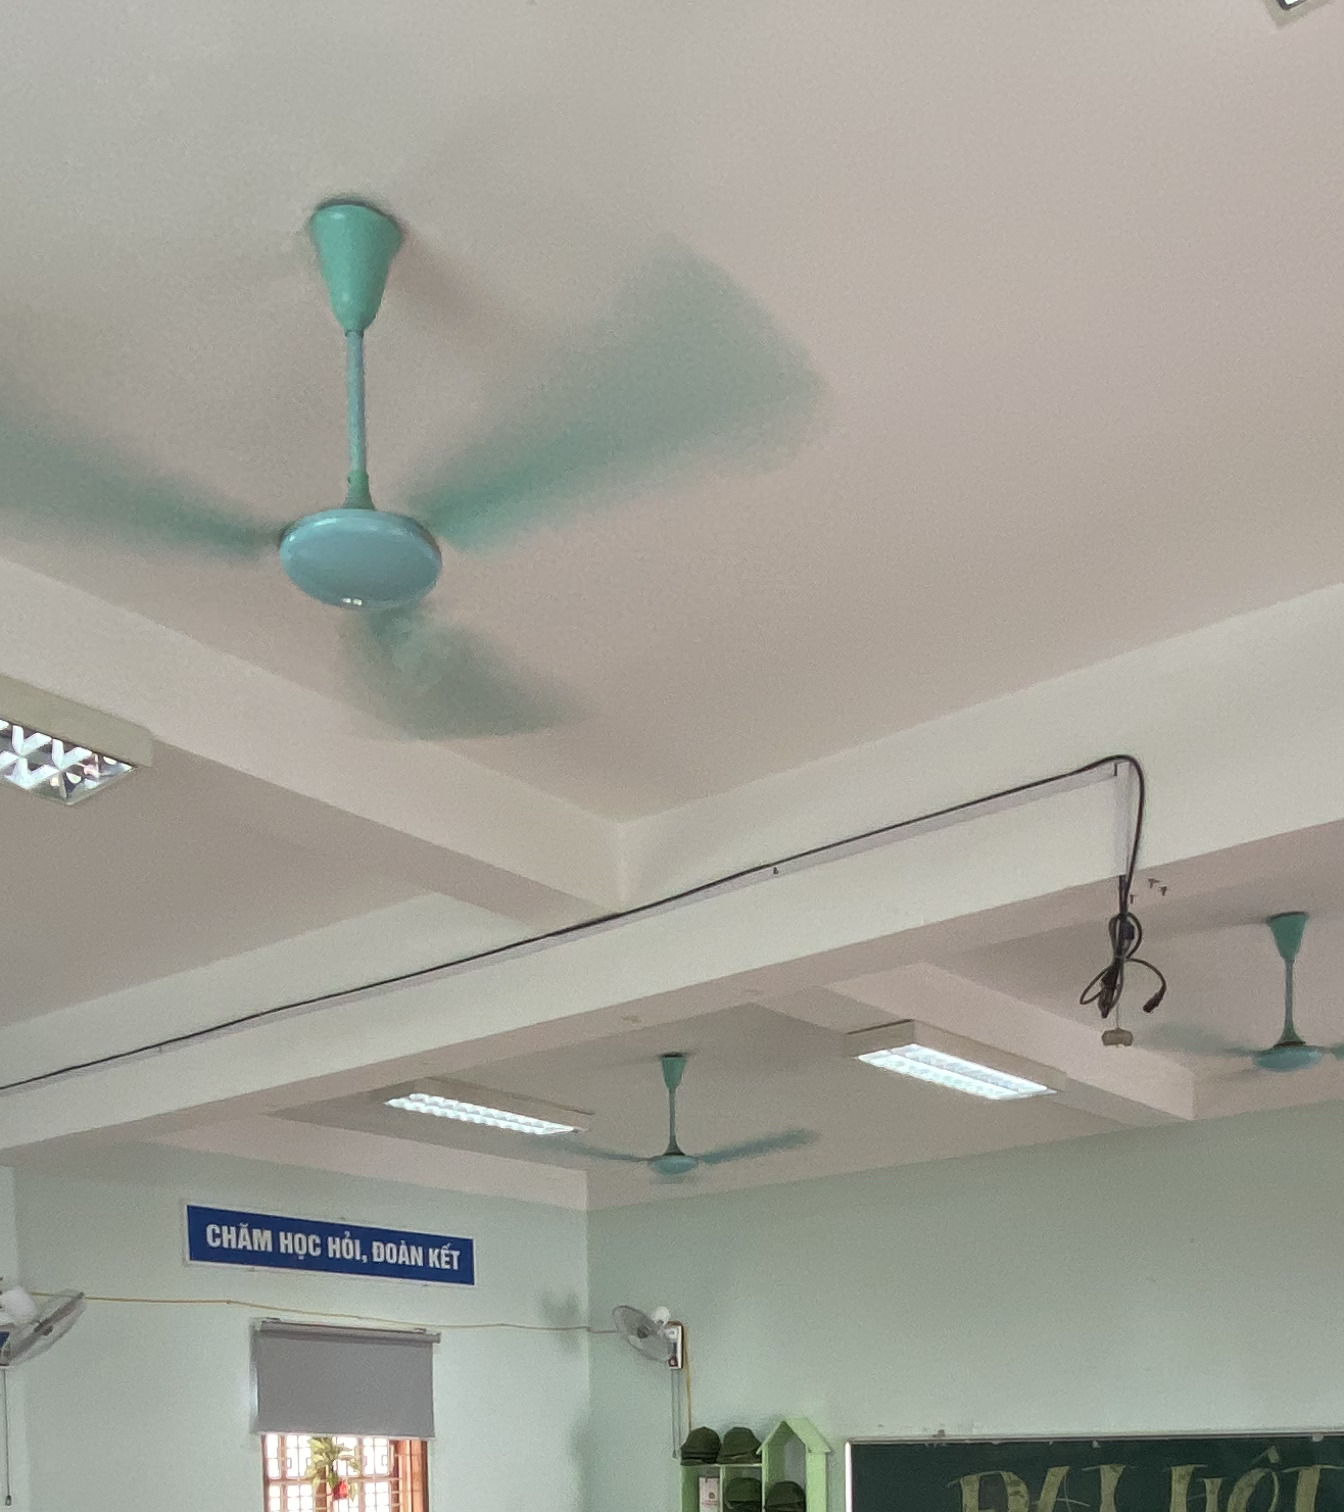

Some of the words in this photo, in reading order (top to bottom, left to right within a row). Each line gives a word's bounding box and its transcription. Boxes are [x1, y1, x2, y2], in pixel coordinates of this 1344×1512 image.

[206, 1223, 272, 1252] CHĂM
[279, 1231, 322, 1260] HỌC
[327, 1230, 368, 1263] HỎI,
[372, 1239, 424, 1267] ĐOÀN
[428, 1242, 461, 1270] KẾT
